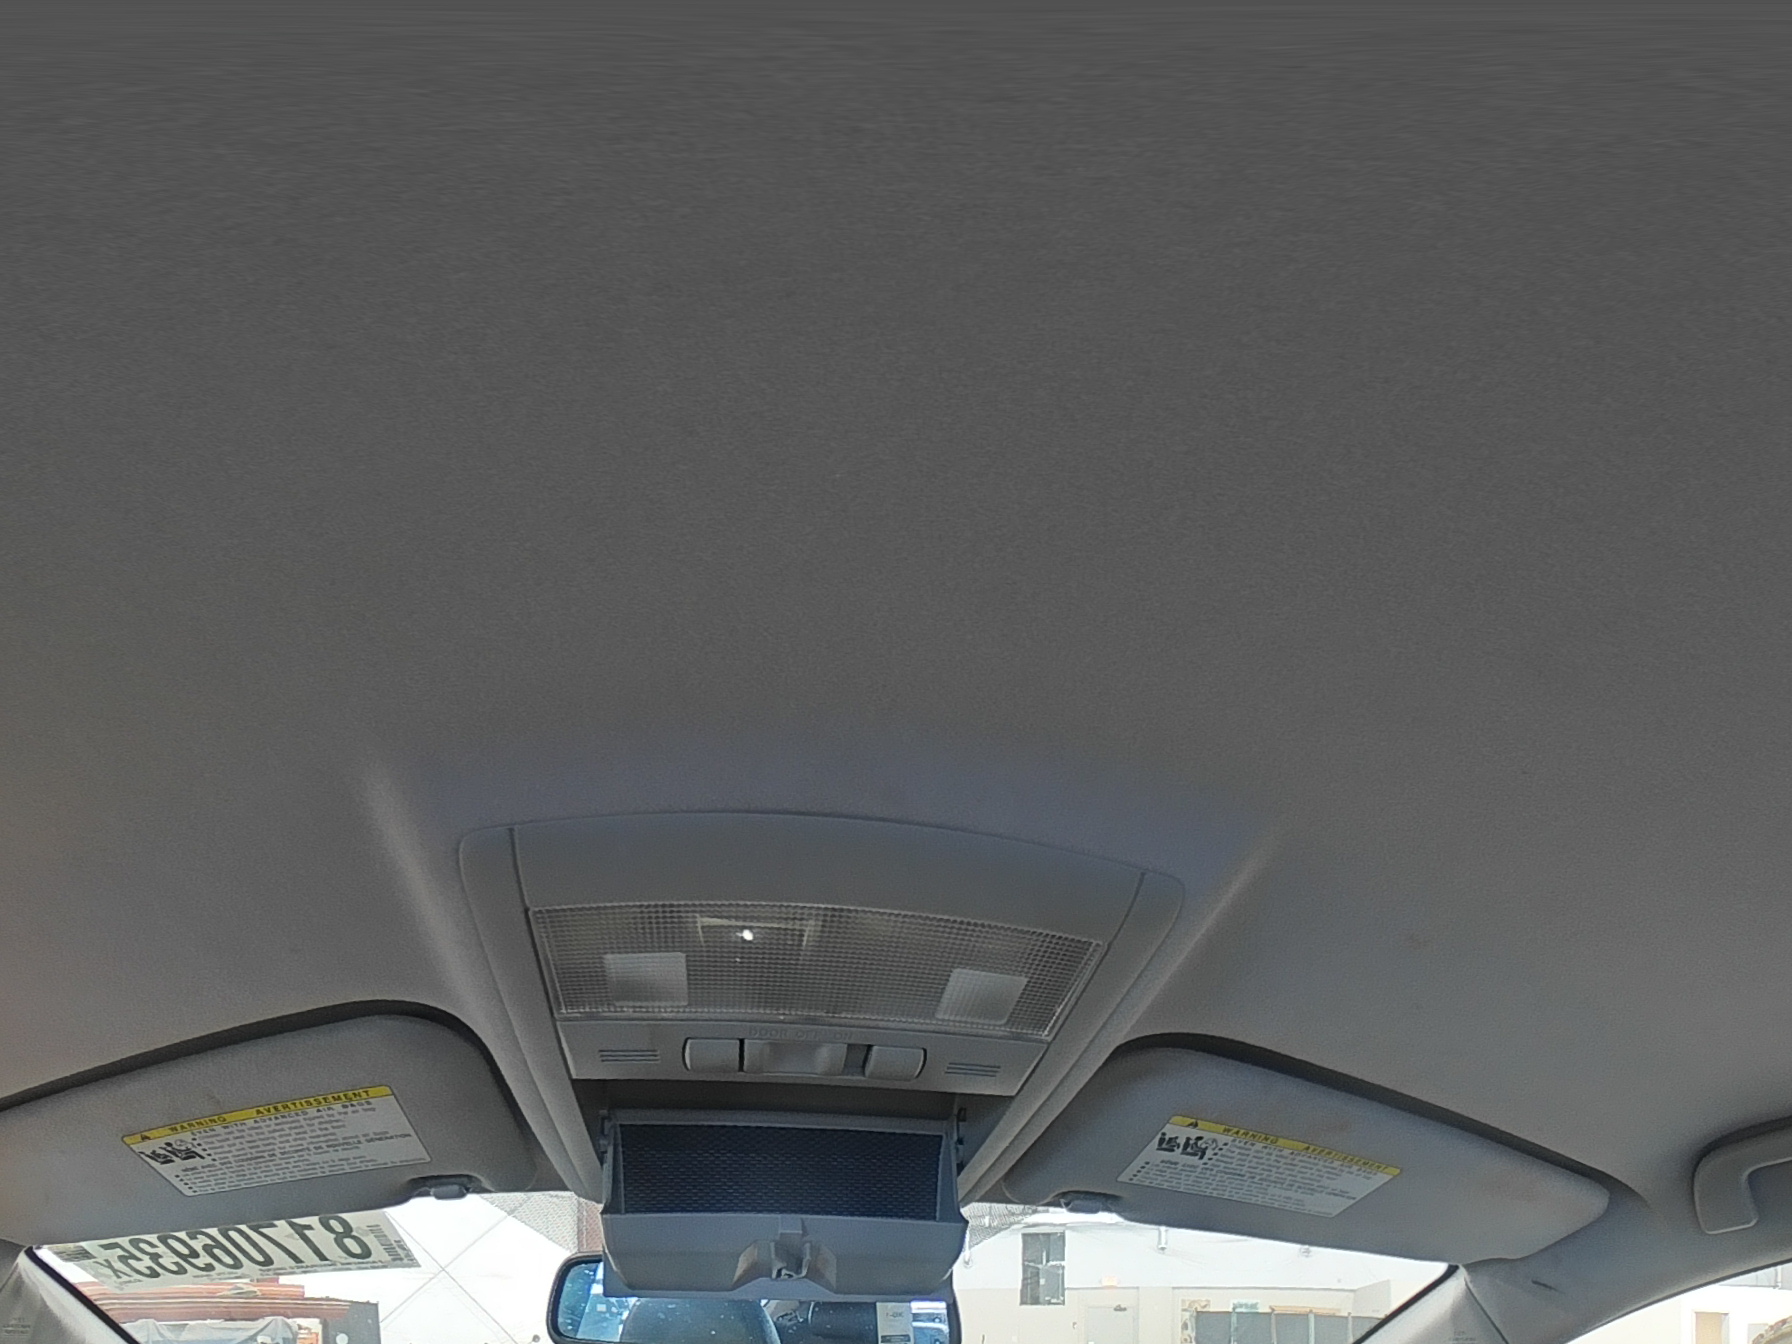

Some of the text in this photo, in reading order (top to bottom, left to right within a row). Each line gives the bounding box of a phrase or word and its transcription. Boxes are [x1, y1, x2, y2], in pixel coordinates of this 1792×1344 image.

[168, 1090, 371, 1134] WARNING AVERTISSEMENT
[253, 1109, 309, 1126] ADVANCED
[1222, 1125, 1278, 1145] WARNING
